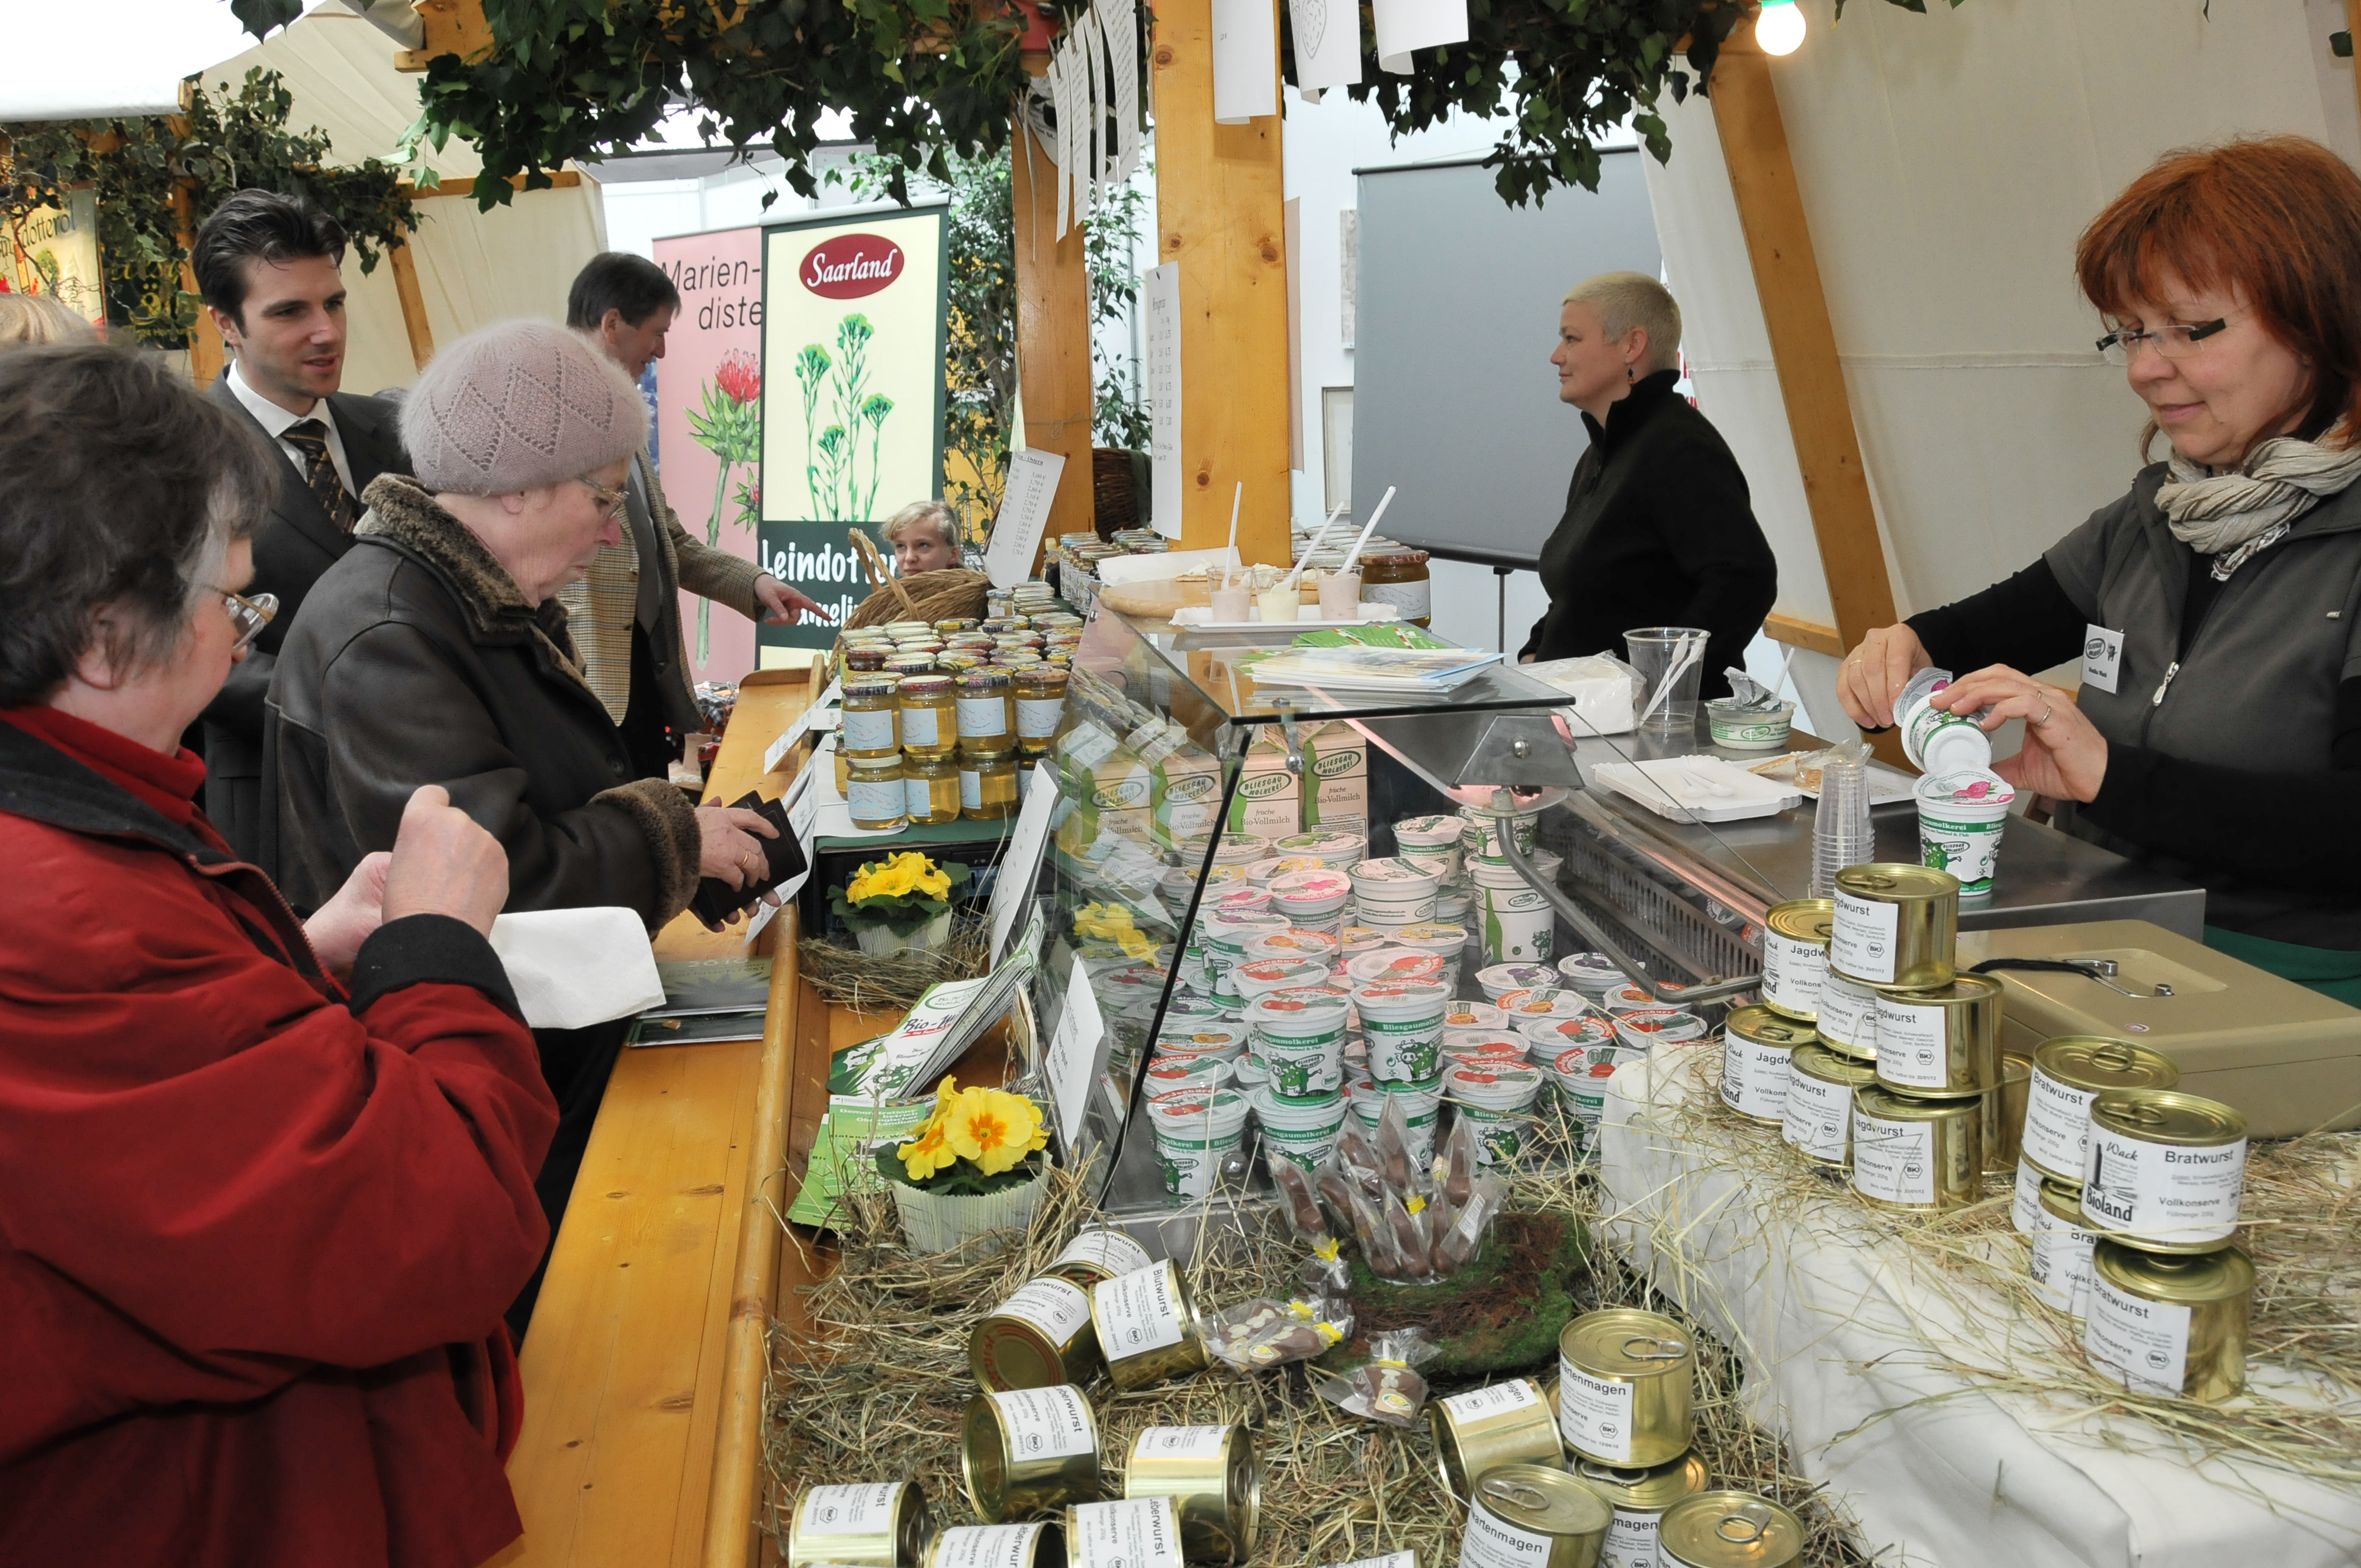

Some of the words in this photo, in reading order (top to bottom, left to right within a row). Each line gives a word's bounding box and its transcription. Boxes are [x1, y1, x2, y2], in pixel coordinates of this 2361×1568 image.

[655, 256, 761, 291] Marien-
[807, 248, 892, 287] Saarland
[699, 296, 762, 330] diste
[762, 539, 898, 585] Leindoter
[1318, 754, 1352, 769] BLIESGAU
[1321, 761, 1353, 774] MOLKEREI
[1244, 776, 1282, 790] BLIESGAU
[1249, 783, 1282, 796] MOLKEREI
[1314, 793, 1360, 804] Bio-Vollmilch
[1240, 816, 1290, 826] Bio-Vollmilch
[1790, 945, 1825, 958] Jagdw
[1790, 978, 1822, 988] Vollkons
[1877, 1007, 1916, 1024] agdwurst
[1469, 1060, 1527, 1070] Bio-Joghurt
[1756, 1052, 1791, 1066] Jagdw
[1755, 1087, 1787, 1097] Vollkons
[2034, 1072, 2084, 1106] Bratwurst
[1856, 1116, 1904, 1136] agdwurst
[2106, 1142, 2138, 1161] Wack
[2165, 1150, 2233, 1164] Bratwurst
[2086, 1186, 2132, 1222] Bioland
[2159, 1197, 2220, 1207] Vollkonserve
[1093, 1232, 1140, 1254] Blutwurst
[1153, 1269, 1170, 1318] Blutwurst
[2095, 1279, 2149, 1319] Bratwurst
[1053, 1387, 1083, 1432] eberwurst
[1009, 1525, 1029, 1568] eberwur
